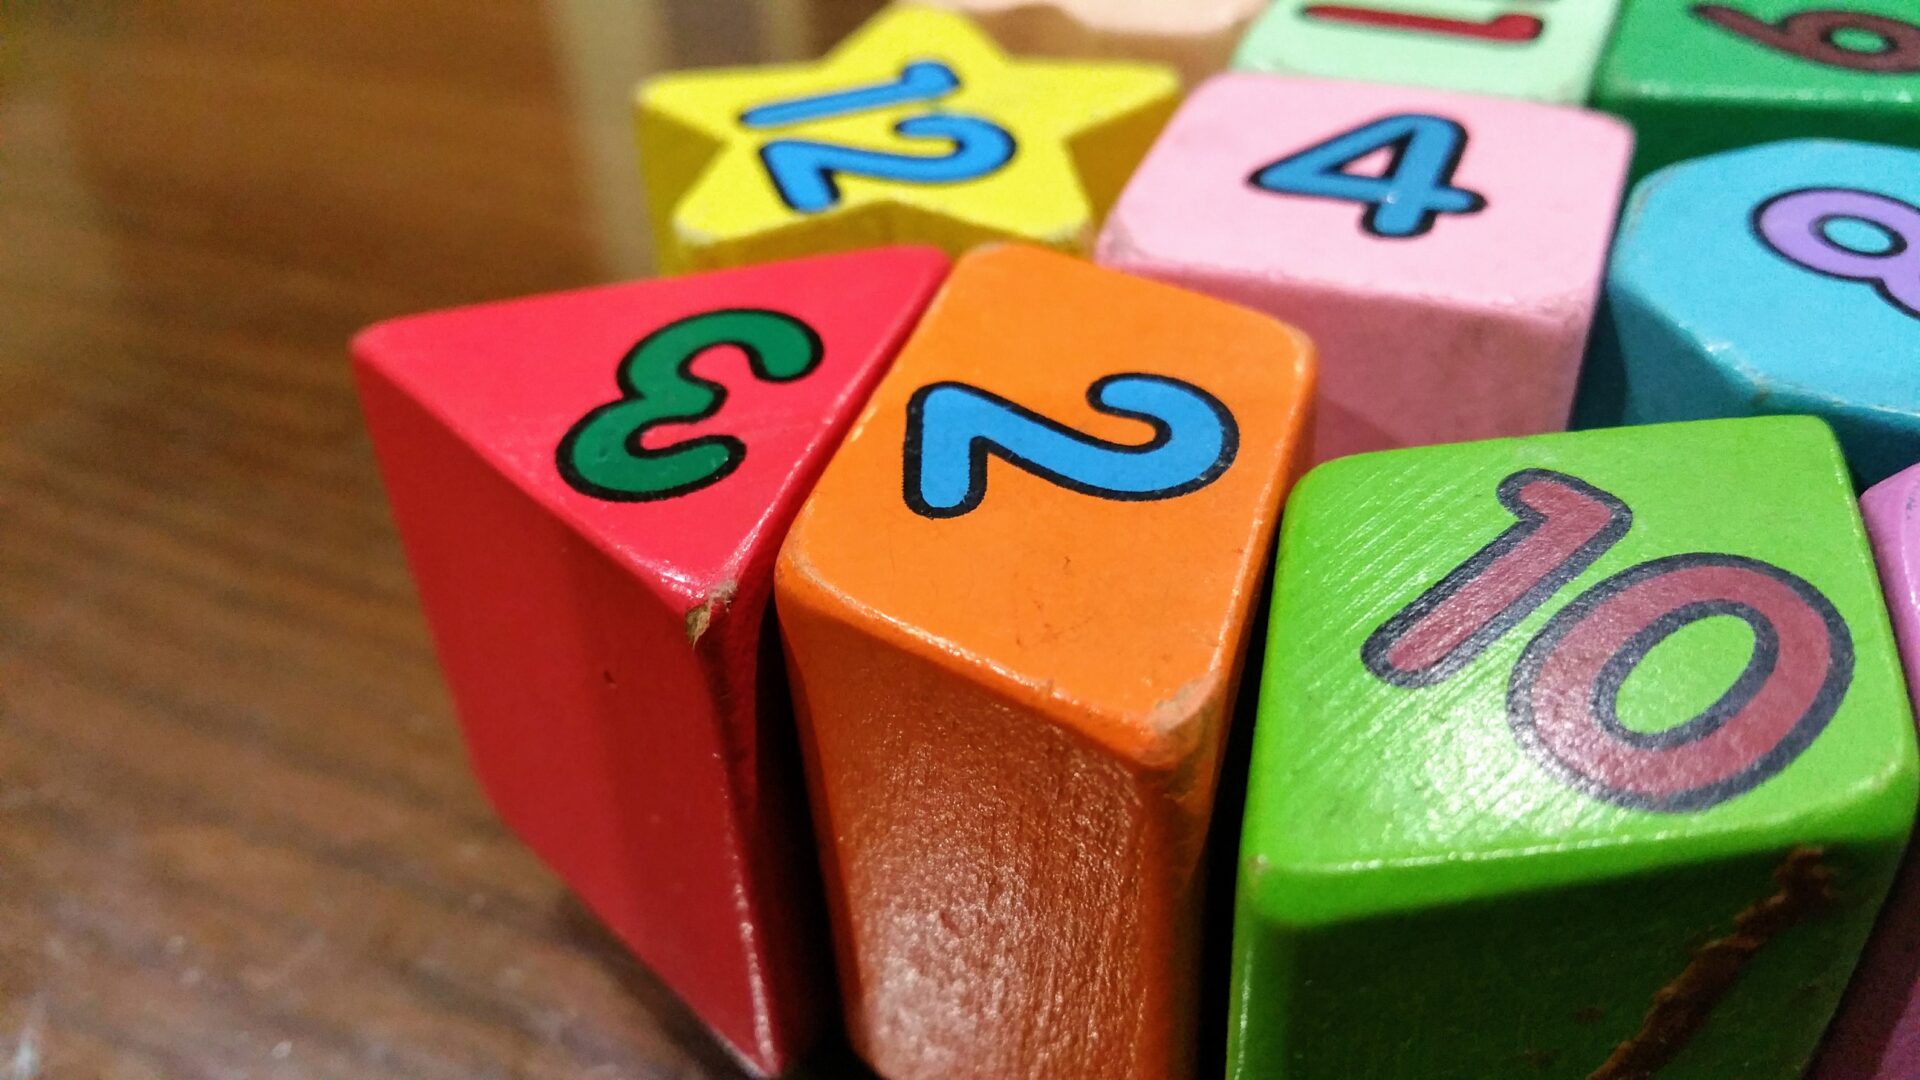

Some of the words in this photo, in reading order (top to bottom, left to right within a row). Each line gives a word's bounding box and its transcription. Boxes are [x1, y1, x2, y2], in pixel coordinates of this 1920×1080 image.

[738, 60, 1018, 215] 12
[1247, 113, 1487, 238] 4
[555, 308, 824, 502] 3
[901, 372, 1240, 519] 2
[1360, 468, 1856, 815] 10
